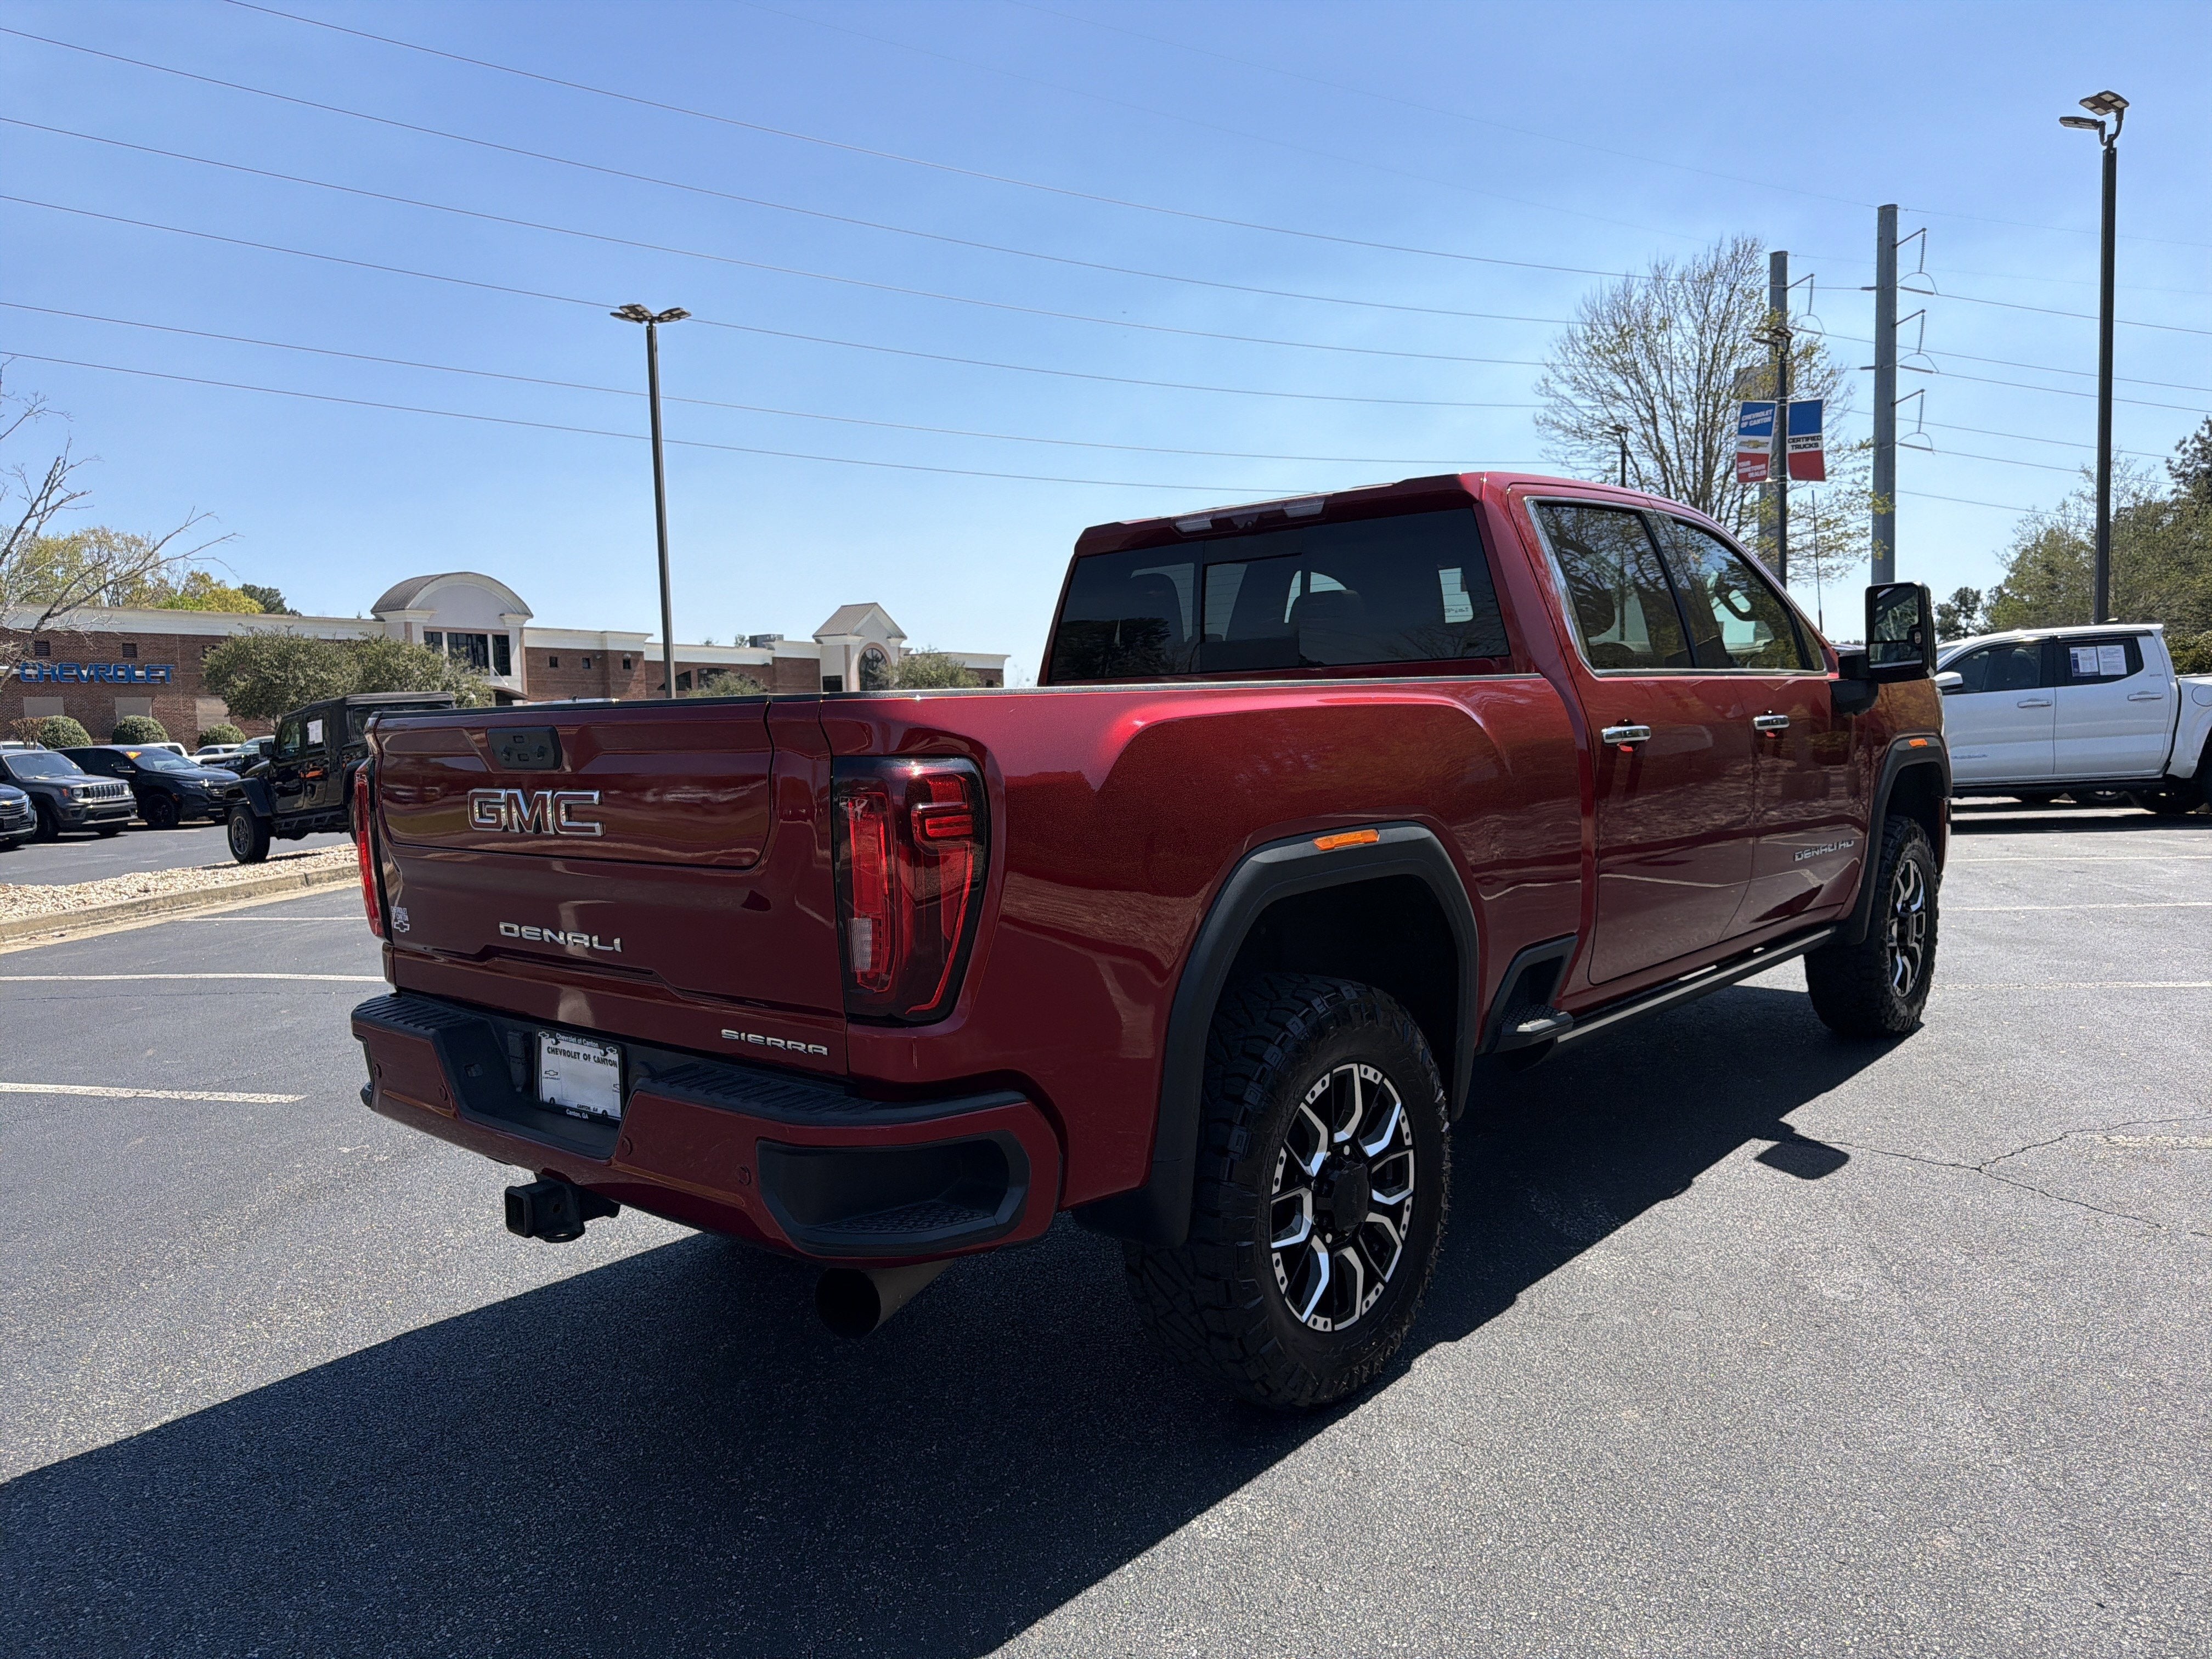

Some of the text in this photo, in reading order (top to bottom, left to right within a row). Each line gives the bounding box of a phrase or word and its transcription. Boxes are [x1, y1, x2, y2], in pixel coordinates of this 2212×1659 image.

[1787, 435, 1822, 443] CERTIFIED
[1791, 442, 1819, 450] TRUCKS
[19, 662, 175, 684] CHEVROLET
[467, 788, 605, 837] GMC
[1793, 839, 1855, 862] DENALI HD
[499, 921, 622, 953] DENALI
[556, 1032, 576, 1042] Chevrolet
[583, 1039, 599, 1048] Canton
[721, 1029, 828, 1056] SIERRA
[546, 1046, 618, 1068] CHEVROLET OF CANTON
